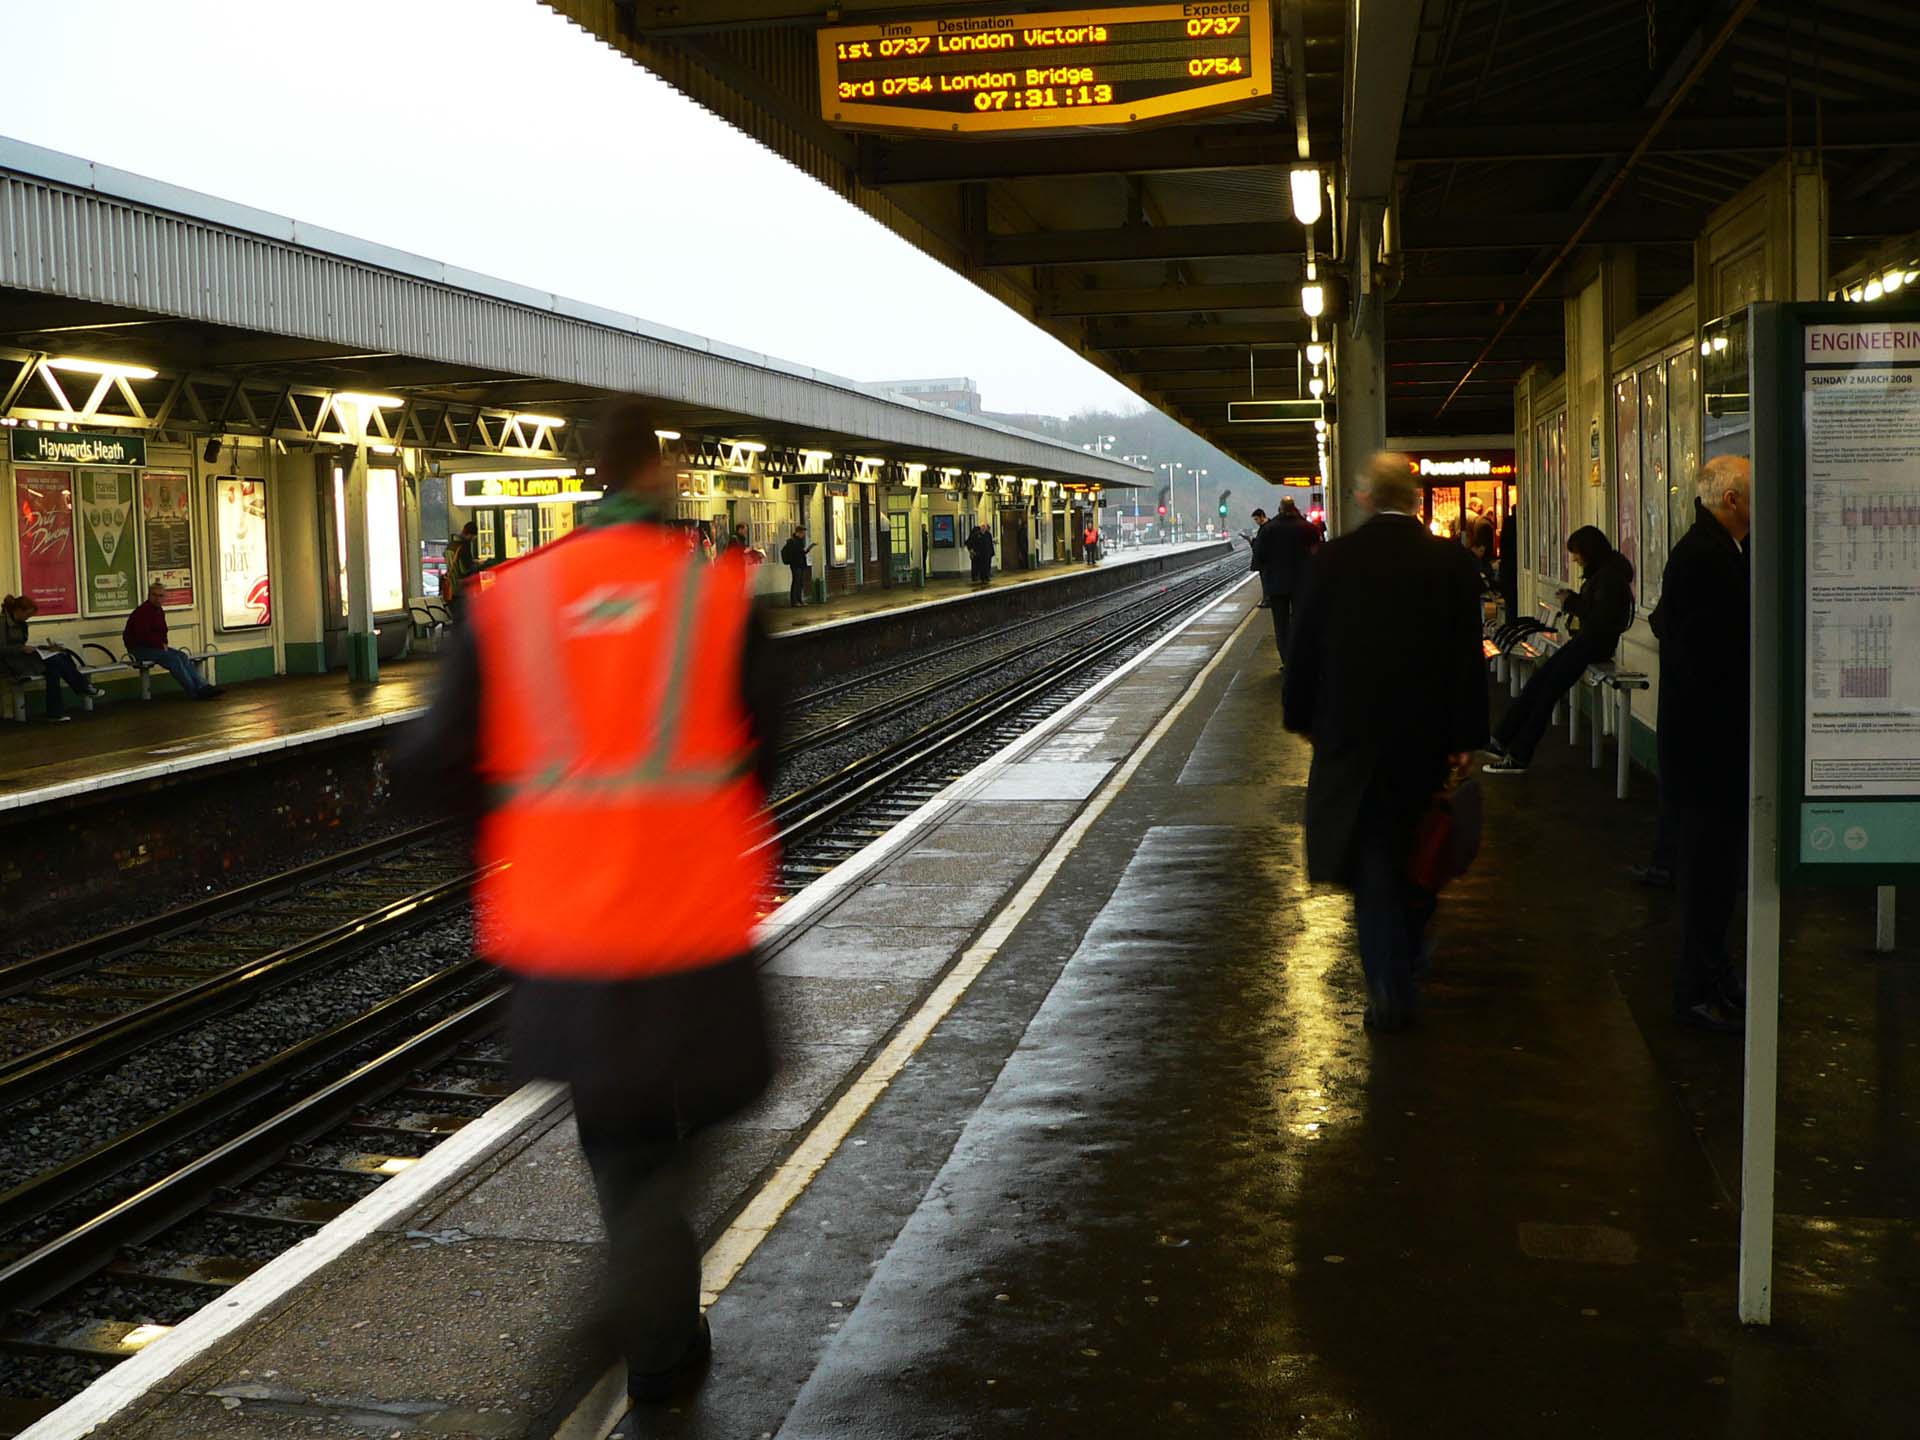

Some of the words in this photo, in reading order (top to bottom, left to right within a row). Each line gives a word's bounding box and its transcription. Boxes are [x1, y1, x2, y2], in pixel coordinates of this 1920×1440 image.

[879, 24, 912, 37] Time
[937, 16, 1014, 33] Destination
[1182, 3, 1250, 18] Expected
[837, 42, 873, 60] 1st
[879, 37, 930, 57] 0737
[937, 32, 1015, 53] London
[1023, 26, 1108, 46] Victoria
[1186, 16, 1241, 36] 0737
[838, 80, 876, 99] 3rd
[882, 76, 933, 95] 0754
[940, 72, 1016, 91] London
[1025, 67, 1094, 86] Bridge
[1188, 57, 1242, 77] 0754
[1811, 375, 1848, 385] SUNDAY
[1849, 376, 1856, 384] 2
[1856, 375, 1889, 384] MARCH
[1890, 374, 1913, 384] 2008
[39, 437, 91, 460] Haywards
[93, 440, 124, 459] Heath
